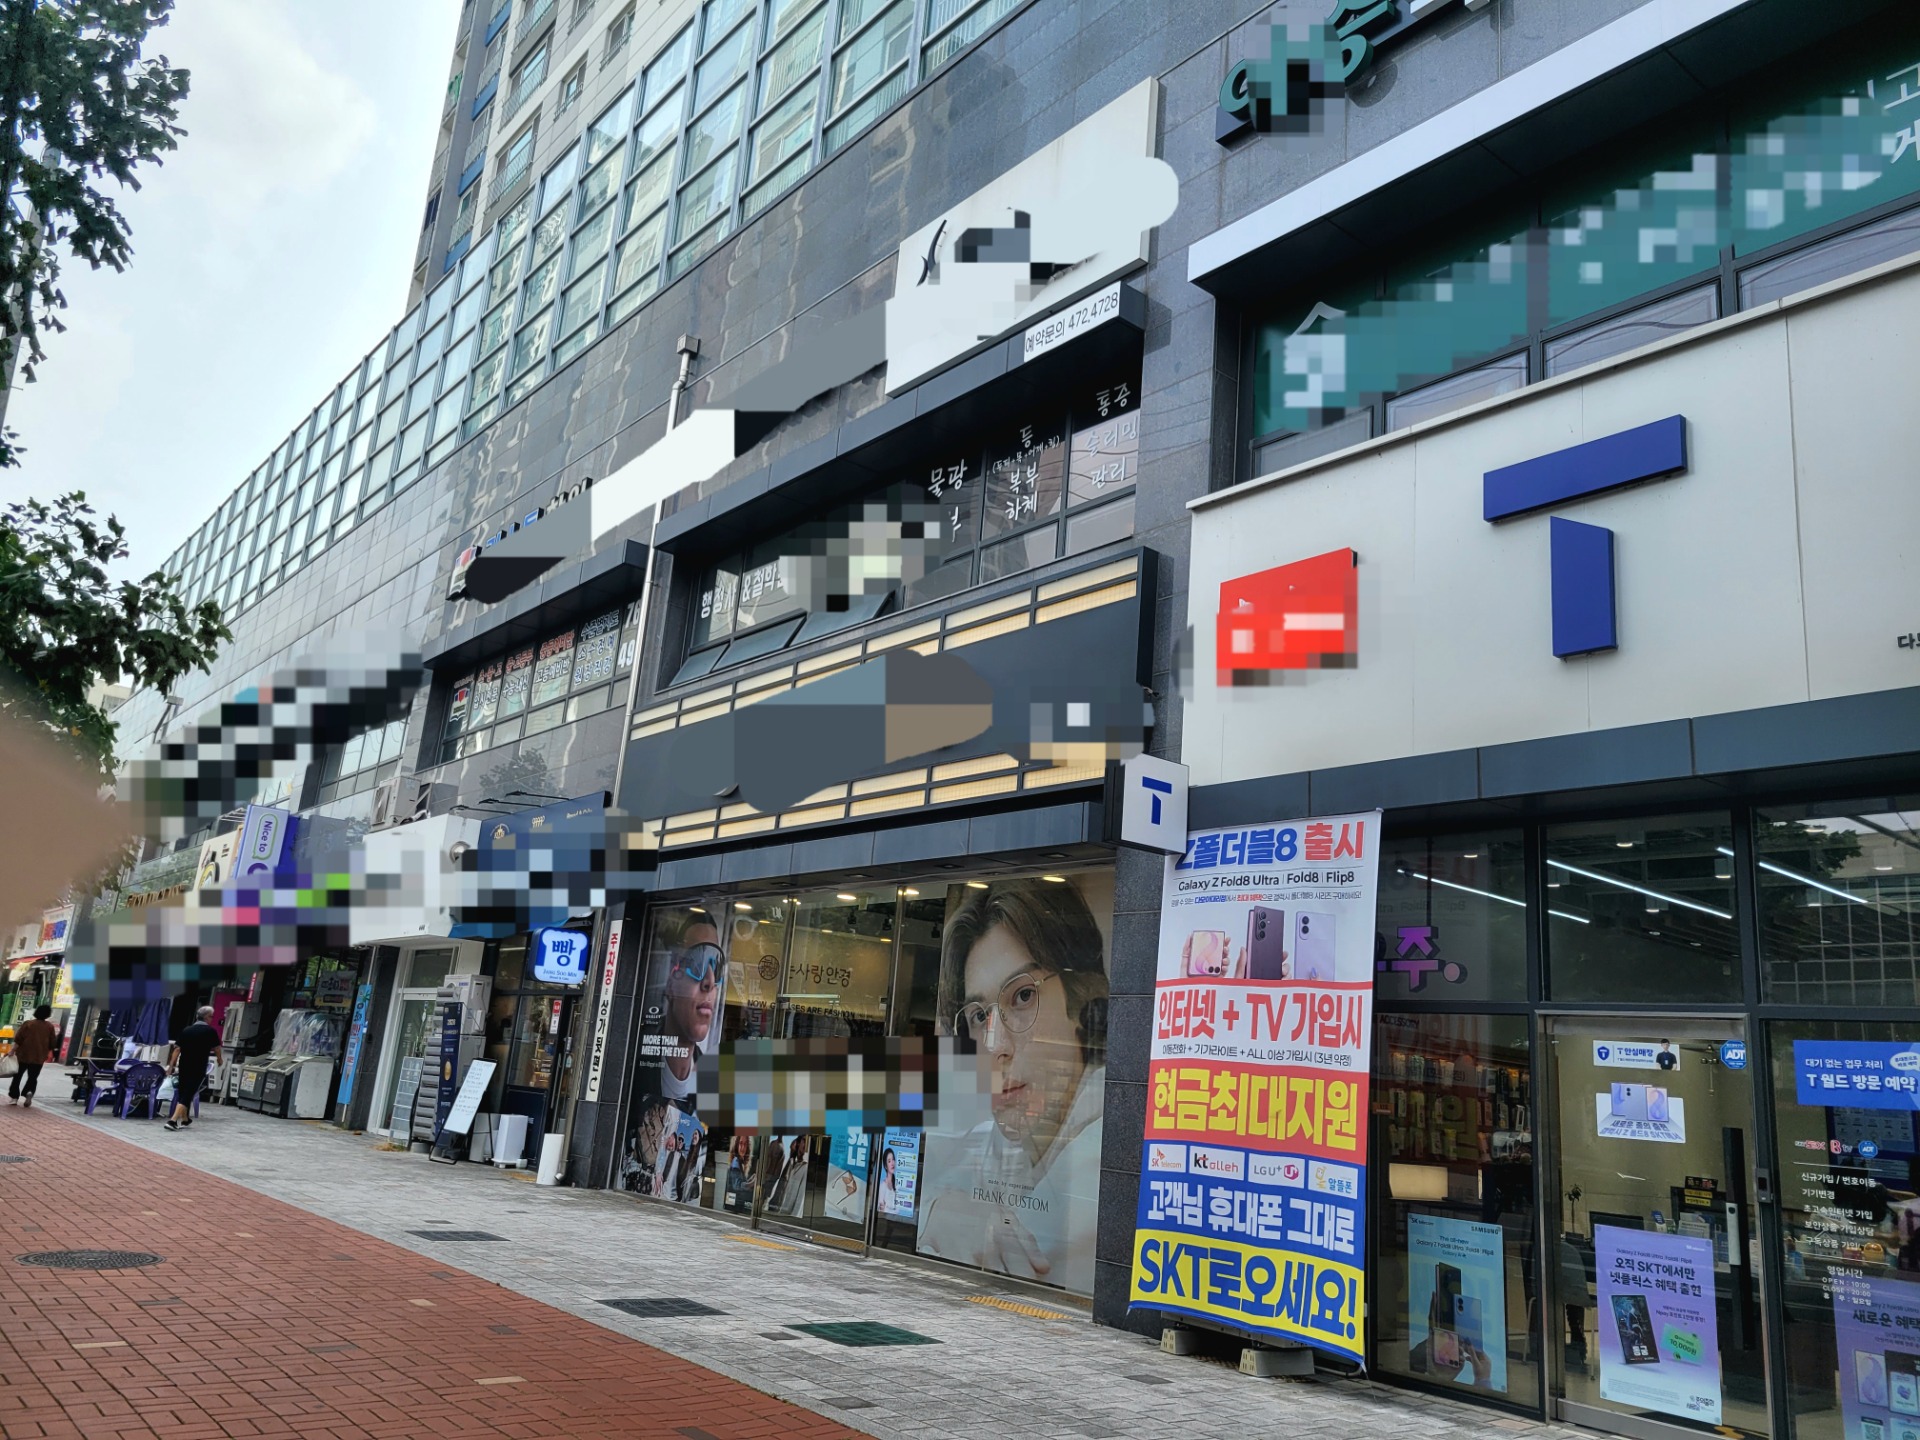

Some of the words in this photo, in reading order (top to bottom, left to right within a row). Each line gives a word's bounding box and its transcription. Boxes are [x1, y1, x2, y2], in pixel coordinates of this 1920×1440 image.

[1026, 319, 1066, 353] 예약문의
[1068, 292, 1119, 328] 472.4728
[1096, 383, 1131, 417] 통증
[1019, 424, 1033, 448] 등
[1086, 416, 1140, 456] 슬리밍
[928, 459, 968, 498] 물광
[1009, 461, 1039, 494] 복부
[1091, 457, 1127, 490] 관리
[1005, 490, 1038, 521] 하체
[1483, 414, 1690, 659] T
[701, 583, 737, 618] 행정사
[1142, 775, 1173, 826] T
[260, 820, 273, 842] Nice
[258, 843, 269, 853] to
[1175, 828, 1298, 871] Z폴더블8
[1304, 820, 1365, 862] 출시
[1178, 879, 1211, 892] Galaxy
[1212, 877, 1220, 887] Z
[1220, 875, 1250, 887] Fold8
[1252, 874, 1280, 886] Ultra
[1286, 871, 1319, 884] Fold8
[1326, 870, 1355, 886] Flip8
[551, 938, 577, 967] 빵
[604, 932, 619, 986] 주차장
[806, 1006, 822, 1015] ARE
[823, 1008, 856, 1019] FASHION
[1157, 988, 1217, 1041] 인터넷
[1222, 999, 1240, 1032] +
[1246, 992, 1289, 1042] TV
[1290, 992, 1364, 1050] 가입시
[641, 1045, 661, 1056] MEETS
[661, 1046, 673, 1057] THE
[673, 1047, 689, 1058] EYES
[642, 1034, 661, 1046] MORE
[661, 1035, 679, 1047] THAN
[1162, 1043, 1186, 1055] 이동전화
[1194, 1043, 1238, 1057] 기가라이트
[1246, 1048, 1266, 1060] ALL
[1267, 1049, 1285, 1061] 이상
[1286, 1049, 1313, 1062] 가입시
[1314, 1051, 1333, 1065] (3년
[1333, 1053, 1352, 1067] 약정)
[1624, 1047, 1654, 1057] 안심매장
[1725, 1049, 1746, 1060] ADT
[1805, 1058, 1823, 1068] 대기
[1825, 1059, 1843, 1069] 없는
[1844, 1059, 1863, 1070] 업무
[1864, 1060, 1884, 1071] 처리
[1806, 1073, 1818, 1087] T
[1821, 1074, 1850, 1089] 월드
[1852, 1075, 1882, 1090] 방문
[1884, 1076, 1916, 1092] 예약
[1153, 1067, 1358, 1151] 현금최대지원
[847, 1146, 867, 1168] LE
[1151, 1158, 1159, 1168] SK
[1161, 1161, 1182, 1169] telecom
[1193, 1153, 1209, 1169] kt
[1328, 1177, 1352, 1195] 알뜰폰
[1801, 1172, 1834, 1184] 신규가입
[1842, 1176, 1877, 1188] 번호이동
[972, 1187, 1005, 1206] FRANK
[1007, 1193, 1049, 1214] CUSTOM
[1802, 1188, 1835, 1200] 기기변경
[1148, 1181, 1203, 1228] 고객님
[1208, 1186, 1283, 1241] 휴대폰
[1287, 1197, 1355, 1255] 그대로
[1803, 1204, 1854, 1218] 초고속인터넷
[1855, 1210, 1873, 1220] 가입
[1471, 1226, 1499, 1235] SAMSUNG
[1805, 1220, 1840, 1233] 보안상품
[1840, 1224, 1875, 1237] 가입상담
[1615, 1257, 1635, 1271] 오직
[1637, 1260, 1696, 1280] SKT에서만
[1827, 1265, 1864, 1279] 영업시간
[1137, 1238, 1358, 1341] SKT로오세요!
[1610, 1271, 1653, 1288] 넷플릭스
[1655, 1279, 1677, 1293] 혜택
[1680, 1282, 1702, 1297] 출현
[1821, 1276, 1845, 1286] OPEN
[1851, 1281, 1871, 1290] 10:00
[1822, 1285, 1845, 1294] CLOSE
[1851, 1289, 1871, 1298] 20:00
[1851, 1296, 1872, 1307] 일요일
[1853, 1309, 1892, 1328] 새로운
[1670, 1338, 1697, 1356] 10,000원
